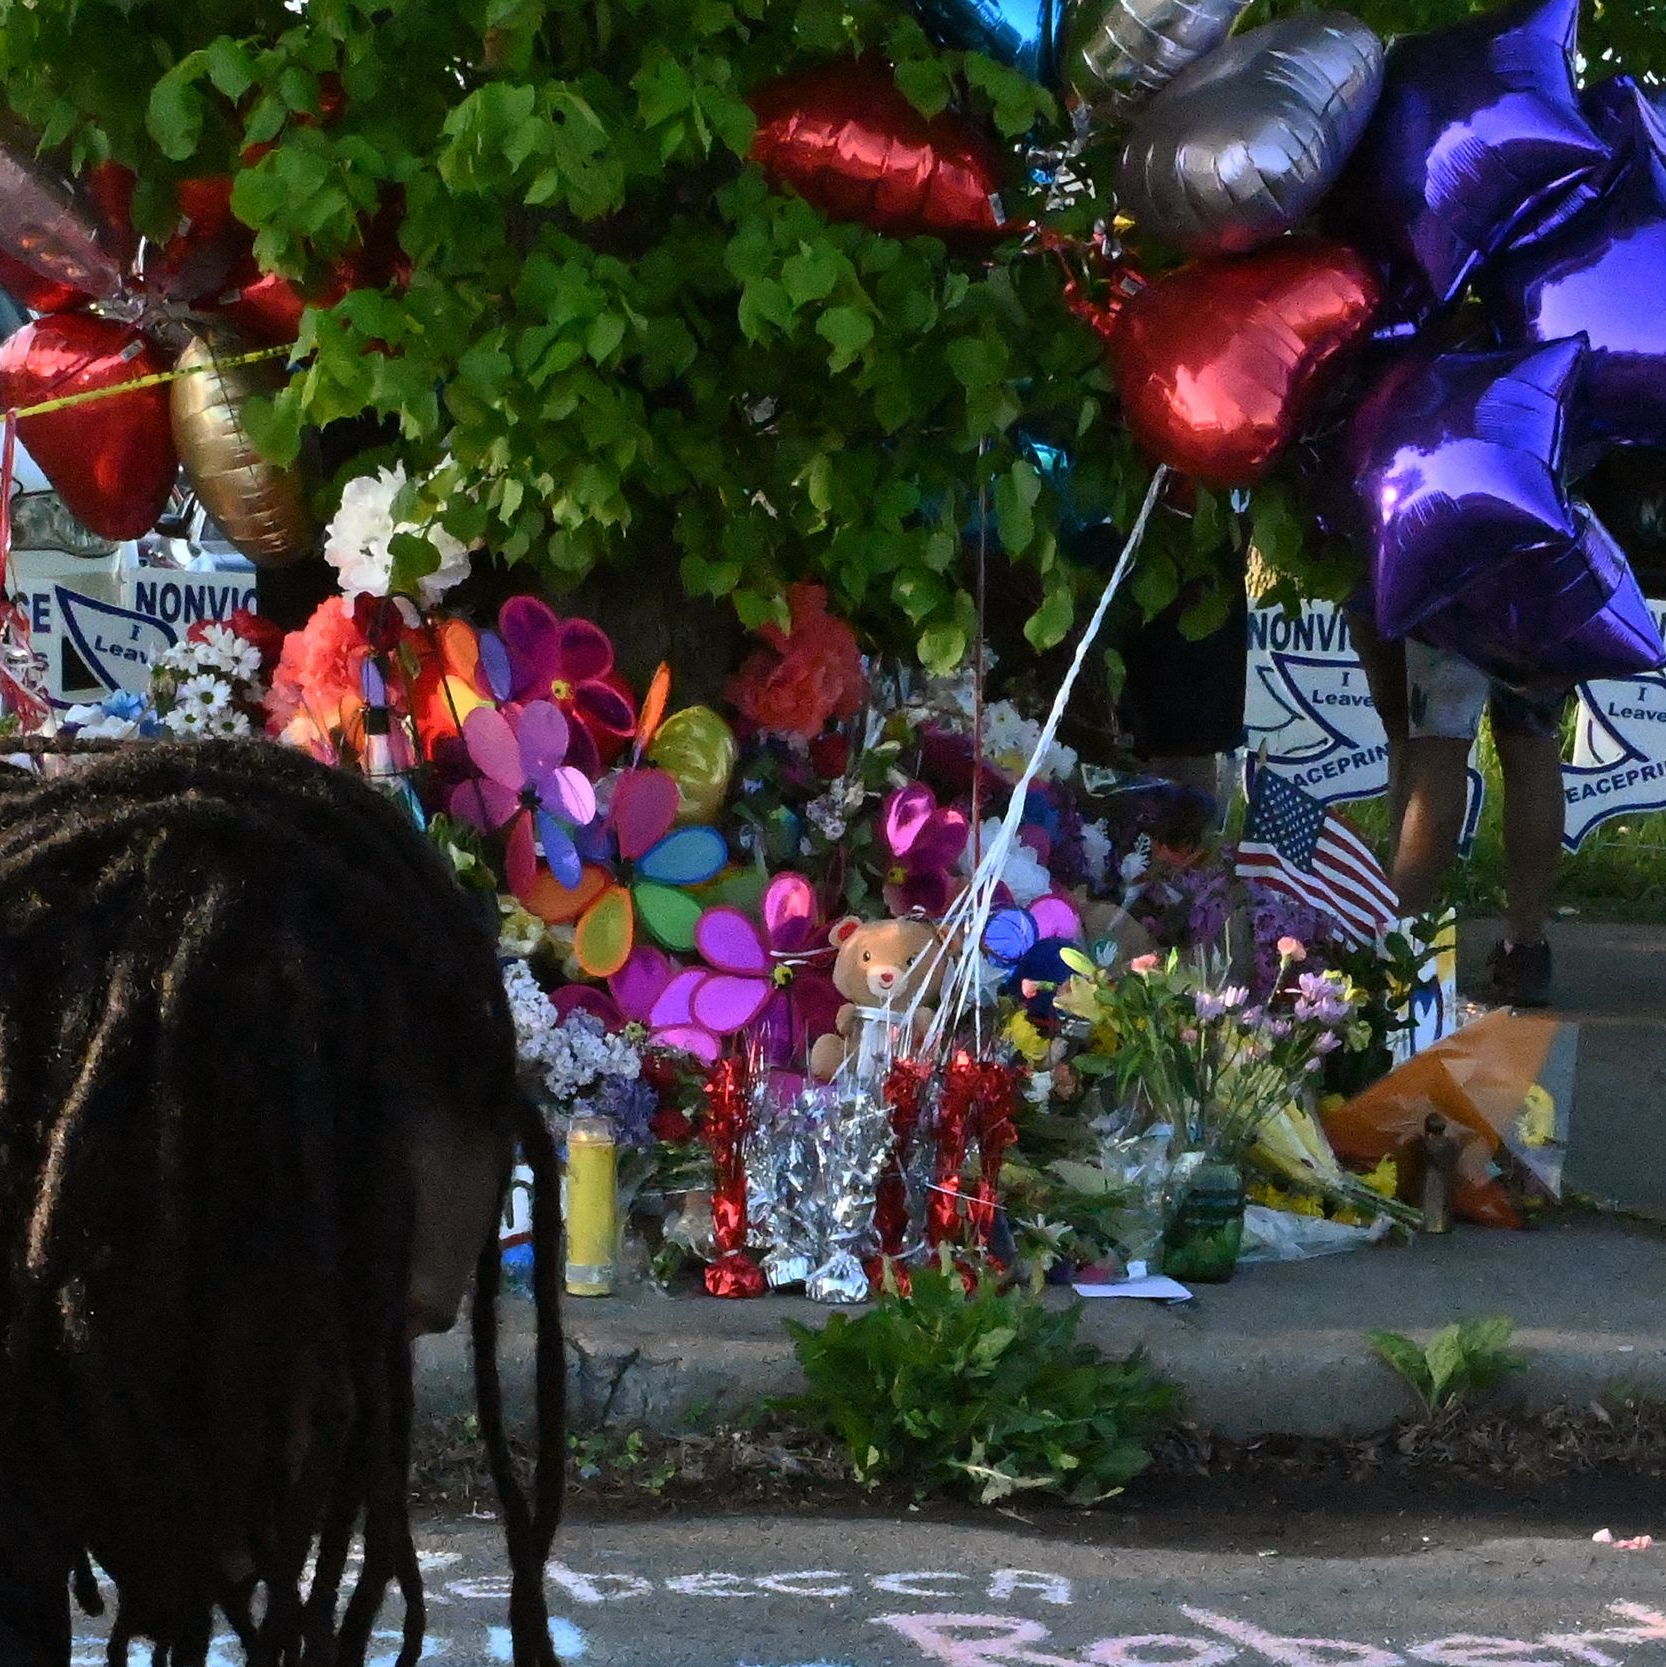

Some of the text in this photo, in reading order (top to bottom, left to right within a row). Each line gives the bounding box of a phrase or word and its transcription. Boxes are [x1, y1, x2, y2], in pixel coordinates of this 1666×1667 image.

[135, 582, 259, 625] NONVIO
[1246, 602, 1350, 652] NONVI
[95, 635, 150, 664] Leav
